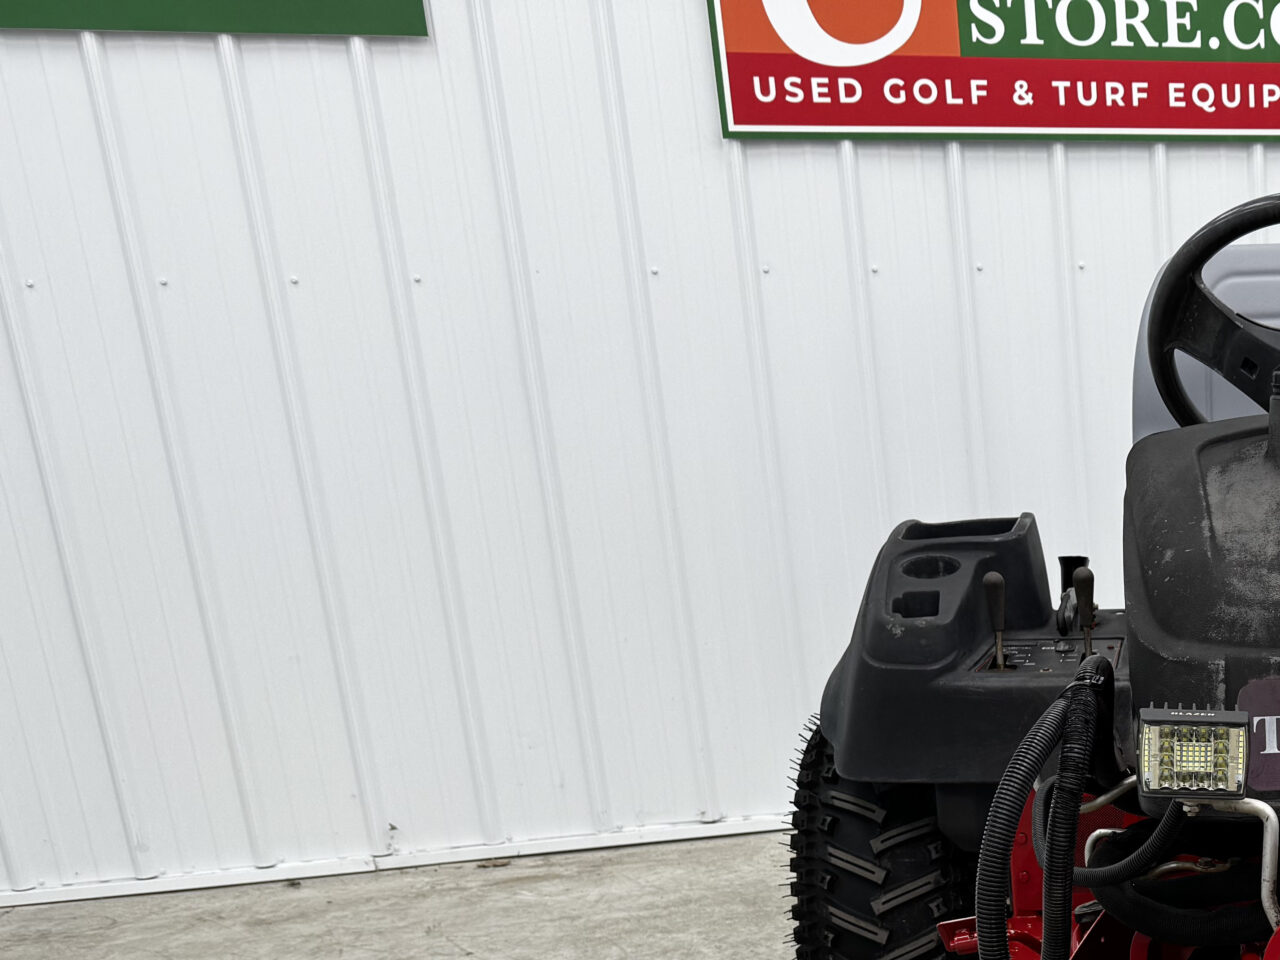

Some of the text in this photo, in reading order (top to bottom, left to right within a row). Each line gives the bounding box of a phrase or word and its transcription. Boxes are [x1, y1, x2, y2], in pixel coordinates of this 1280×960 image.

[752, 75, 864, 105] USED
[883, 77, 989, 106] GOLF
[1012, 79, 1035, 106] &
[1051, 80, 1150, 108] TURF
